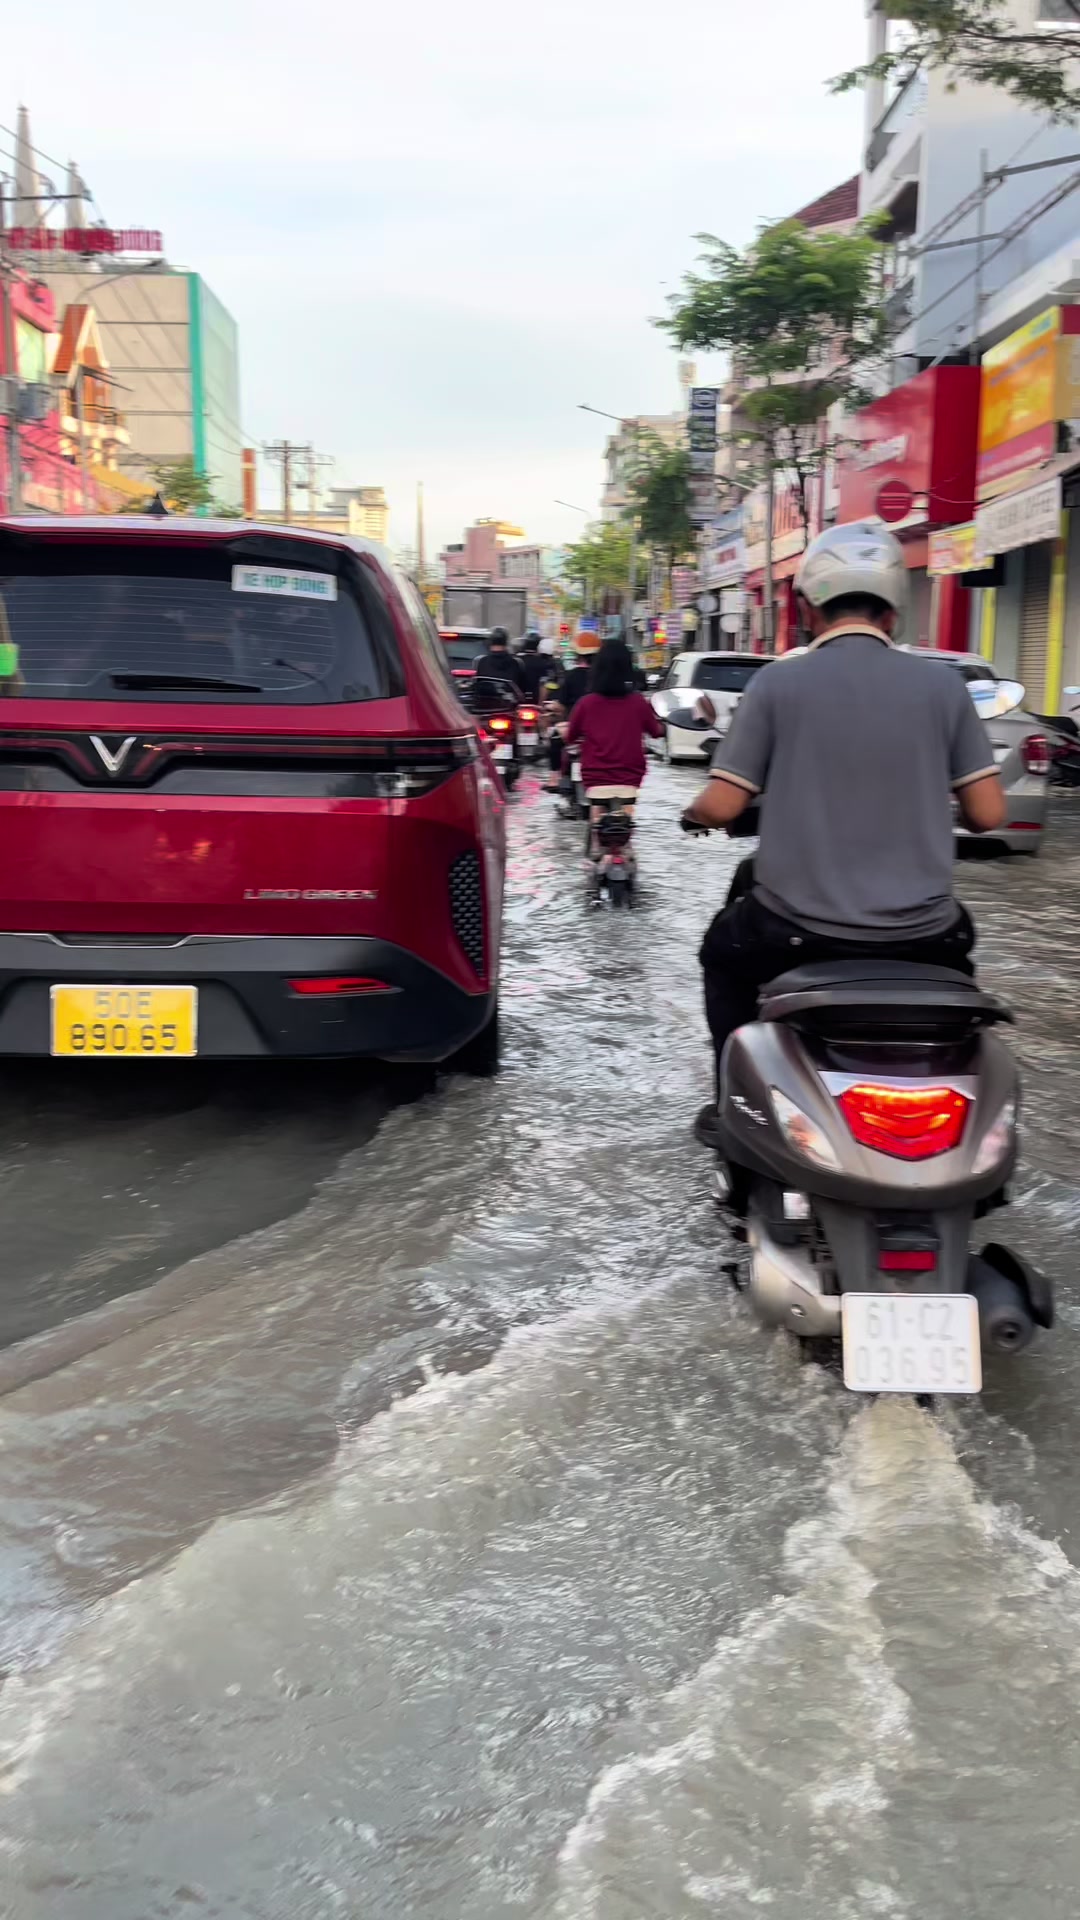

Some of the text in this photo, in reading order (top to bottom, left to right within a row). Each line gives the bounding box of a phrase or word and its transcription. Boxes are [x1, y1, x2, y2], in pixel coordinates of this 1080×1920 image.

[94, 991, 154, 1019] 50E
[71, 1023, 177, 1051] 890.65
[855, 1345, 968, 1385] 036.95
